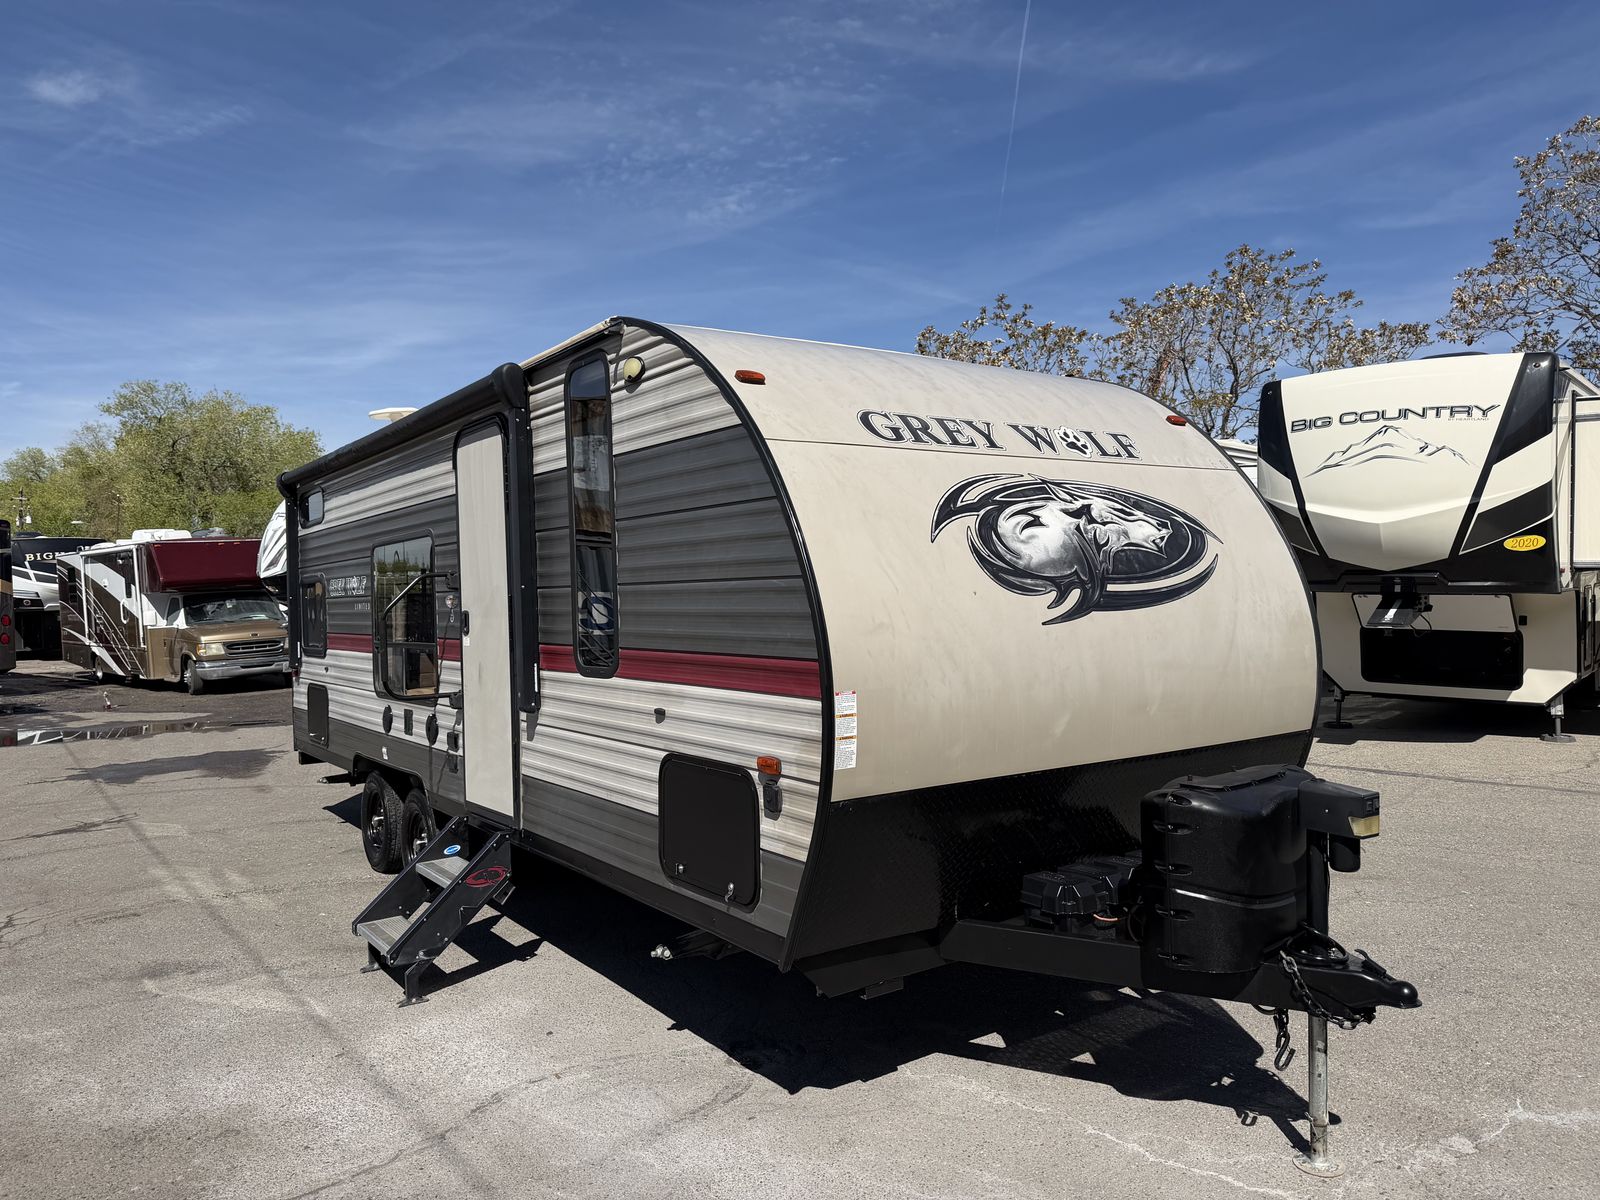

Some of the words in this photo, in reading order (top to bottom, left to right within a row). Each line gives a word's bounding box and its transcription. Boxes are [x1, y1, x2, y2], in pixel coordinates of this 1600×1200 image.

[856, 408, 1006, 451] GREY
[1290, 416, 1333, 433] BIG
[1339, 404, 1501, 425] COUNTRY
[1510, 537, 1539, 549] 2020
